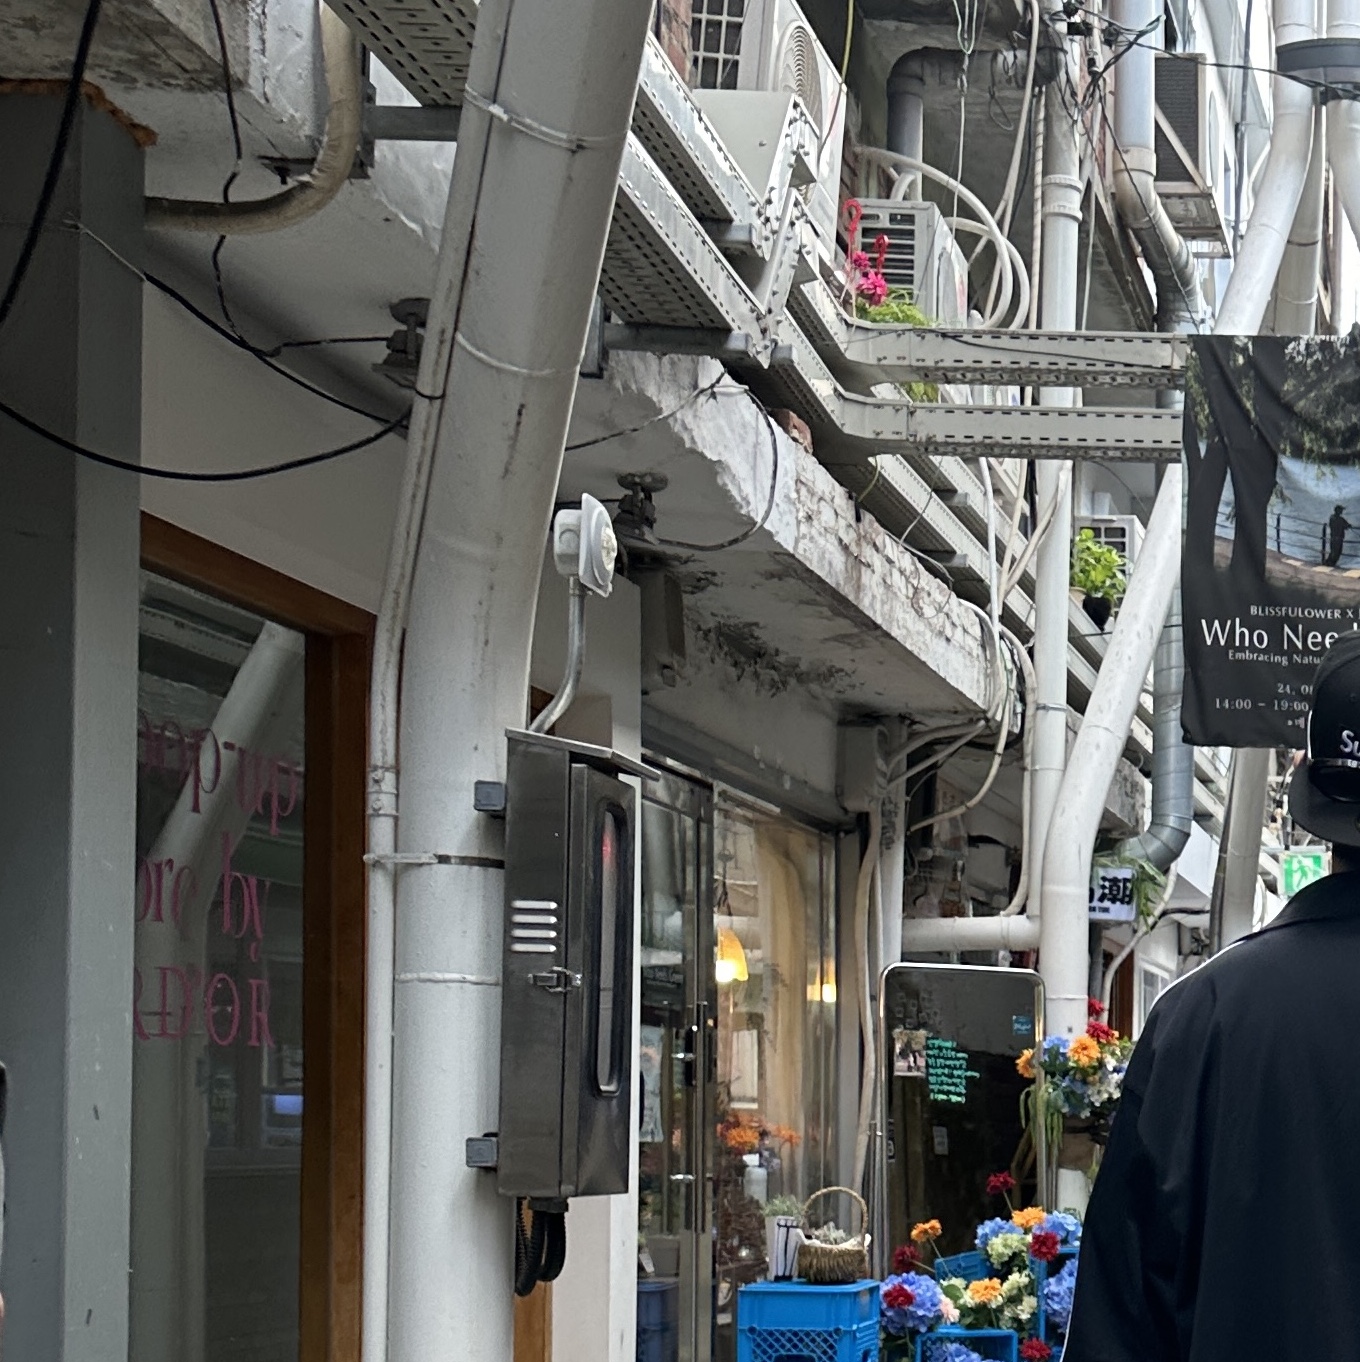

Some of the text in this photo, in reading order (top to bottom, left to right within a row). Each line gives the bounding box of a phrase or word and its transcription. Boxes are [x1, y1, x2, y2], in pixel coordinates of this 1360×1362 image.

[1250, 605, 1341, 619] BLISSFULOWER
[1201, 617, 1268, 649] Who
[1283, 622, 1358, 651] Nee
[1228, 649, 1324, 667] Embracing Natu
[1215, 697, 1251, 711] 14:00
[1273, 699, 1309, 712] 19:00
[222, 831, 271, 963] by
